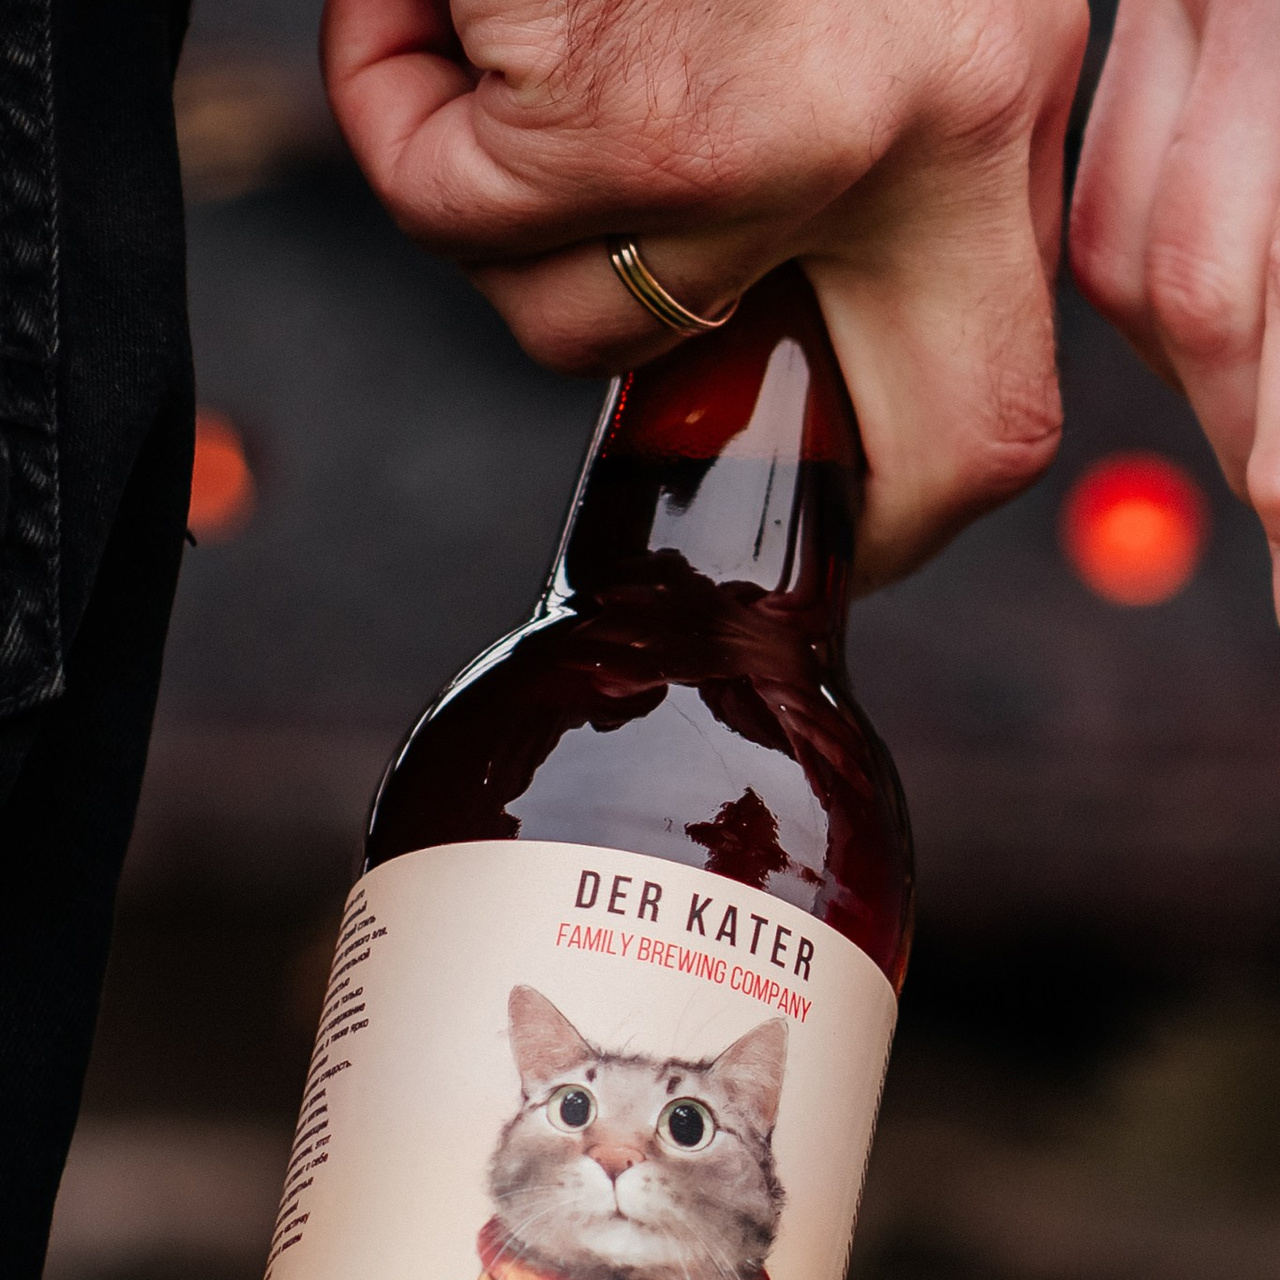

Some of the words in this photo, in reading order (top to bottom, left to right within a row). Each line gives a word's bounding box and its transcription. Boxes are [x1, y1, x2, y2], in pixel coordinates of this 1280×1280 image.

[556, 922, 634, 957] FAMILY
[637, 936, 727, 984] BREWING
[730, 966, 812, 1023] COMPANY
[574, 870, 663, 922] DER
[685, 892, 815, 982] KATER
